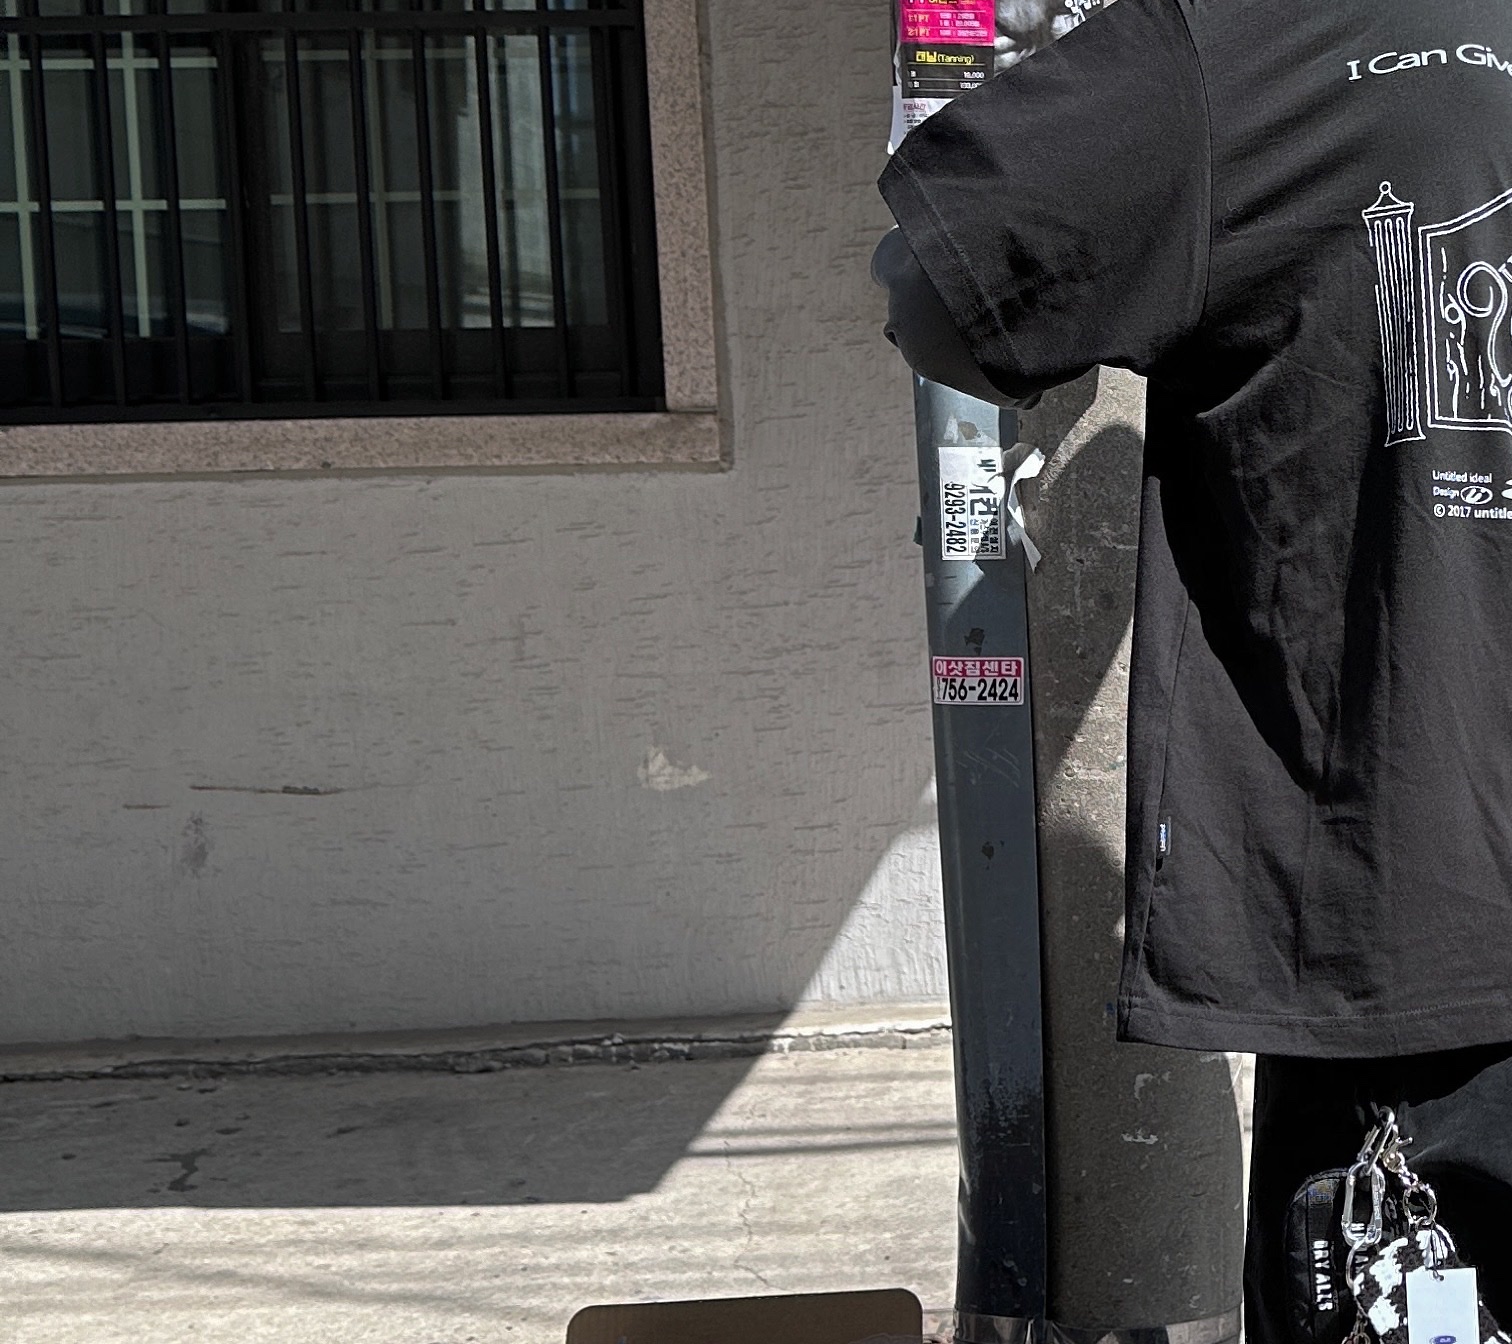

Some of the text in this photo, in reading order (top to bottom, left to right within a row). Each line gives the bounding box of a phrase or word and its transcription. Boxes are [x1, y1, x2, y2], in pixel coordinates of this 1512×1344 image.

[1346, 59, 1362, 81] I
[1368, 48, 1448, 74] Can
[1432, 469, 1493, 484] Untitled ideal
[1432, 486, 1459, 498] Design
[944, 483, 967, 553] 9293-2482
[1447, 505, 1471, 518] 2017
[941, 677, 1019, 701] 756-2424
